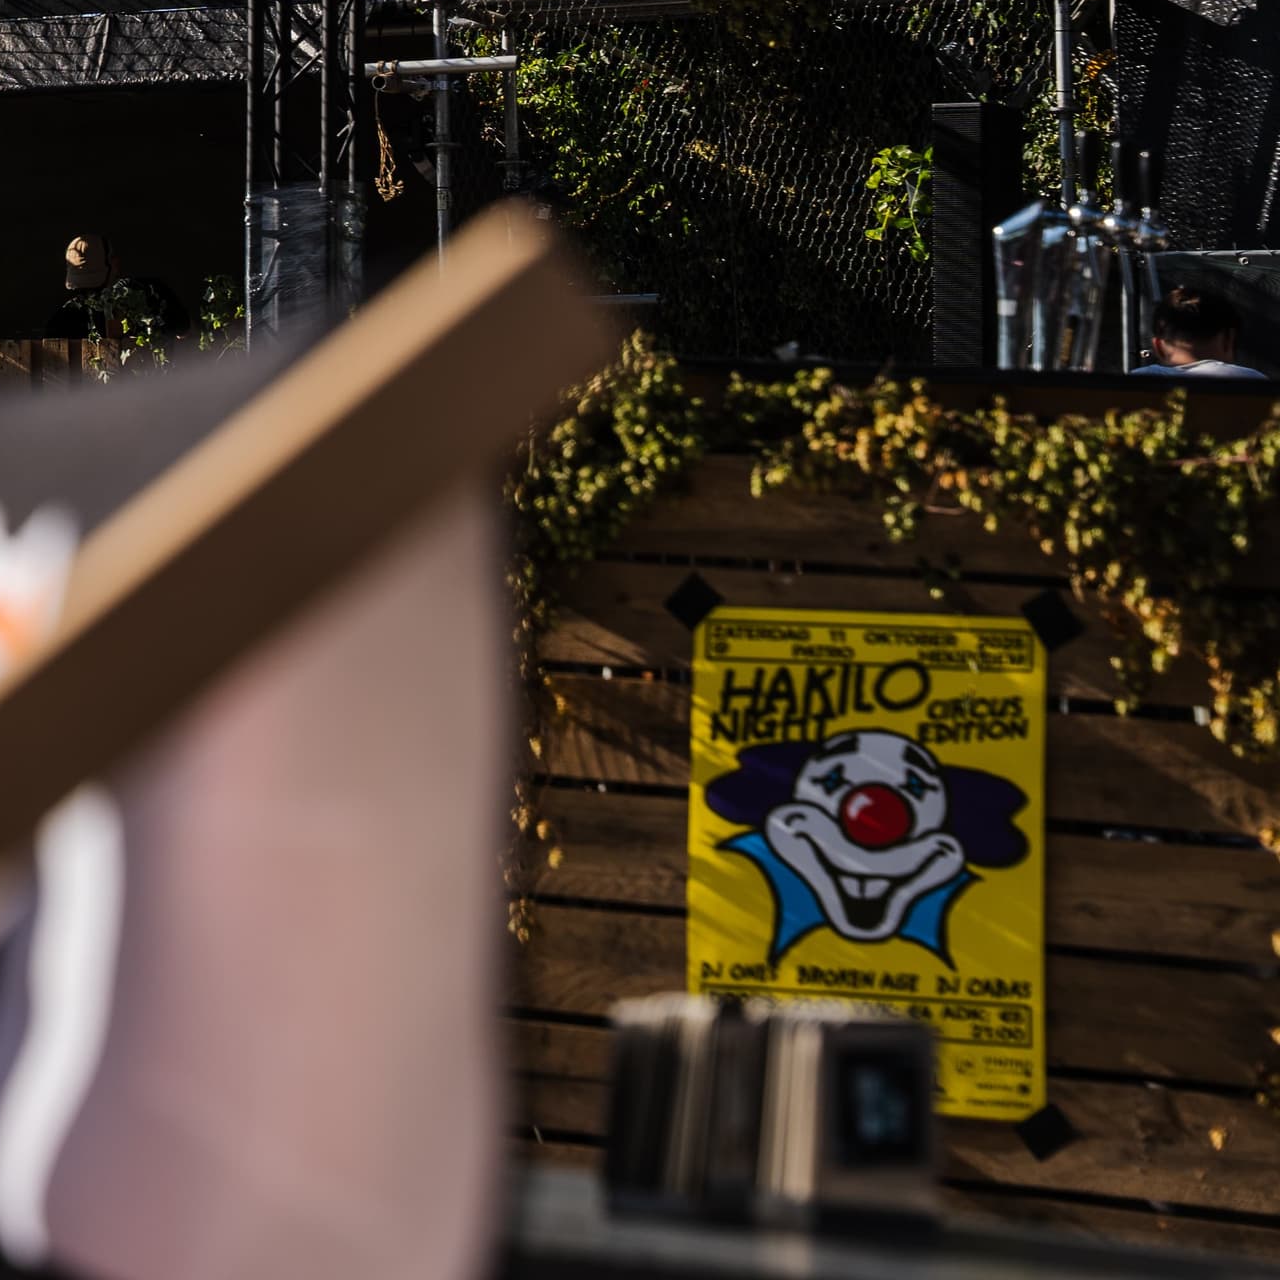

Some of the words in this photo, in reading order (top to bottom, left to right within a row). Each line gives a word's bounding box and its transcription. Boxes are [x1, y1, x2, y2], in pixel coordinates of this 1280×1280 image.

[863, 630, 958, 648] OKTOBER
[721, 660, 932, 721] HAKILO
[926, 696, 1025, 721] CIRCUS
[710, 708, 827, 743] NIGHT
[917, 719, 1030, 745] EDITION
